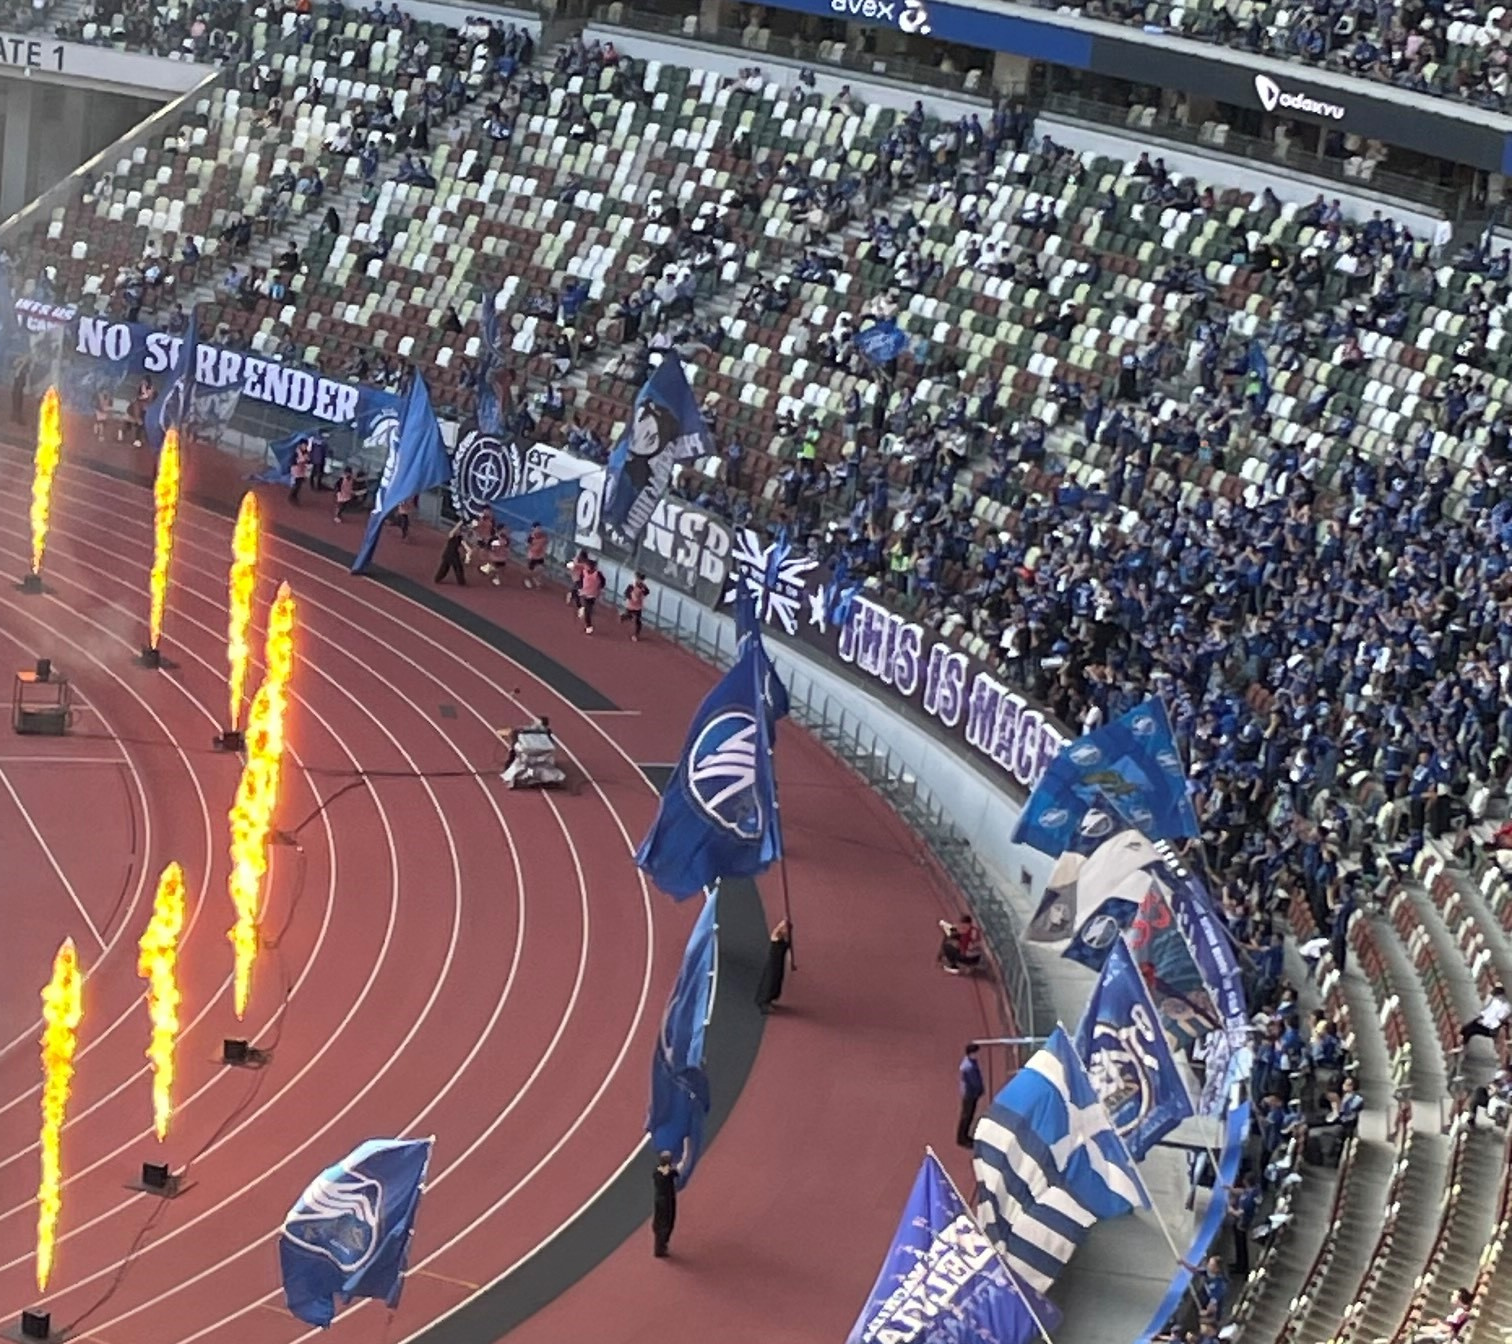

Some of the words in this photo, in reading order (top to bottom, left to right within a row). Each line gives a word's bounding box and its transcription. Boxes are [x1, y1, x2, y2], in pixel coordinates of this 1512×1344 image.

[53, 45, 65, 72] 1
[76, 316, 132, 361] NO
[838, 594, 924, 697] THIS
[923, 642, 970, 728] IS
